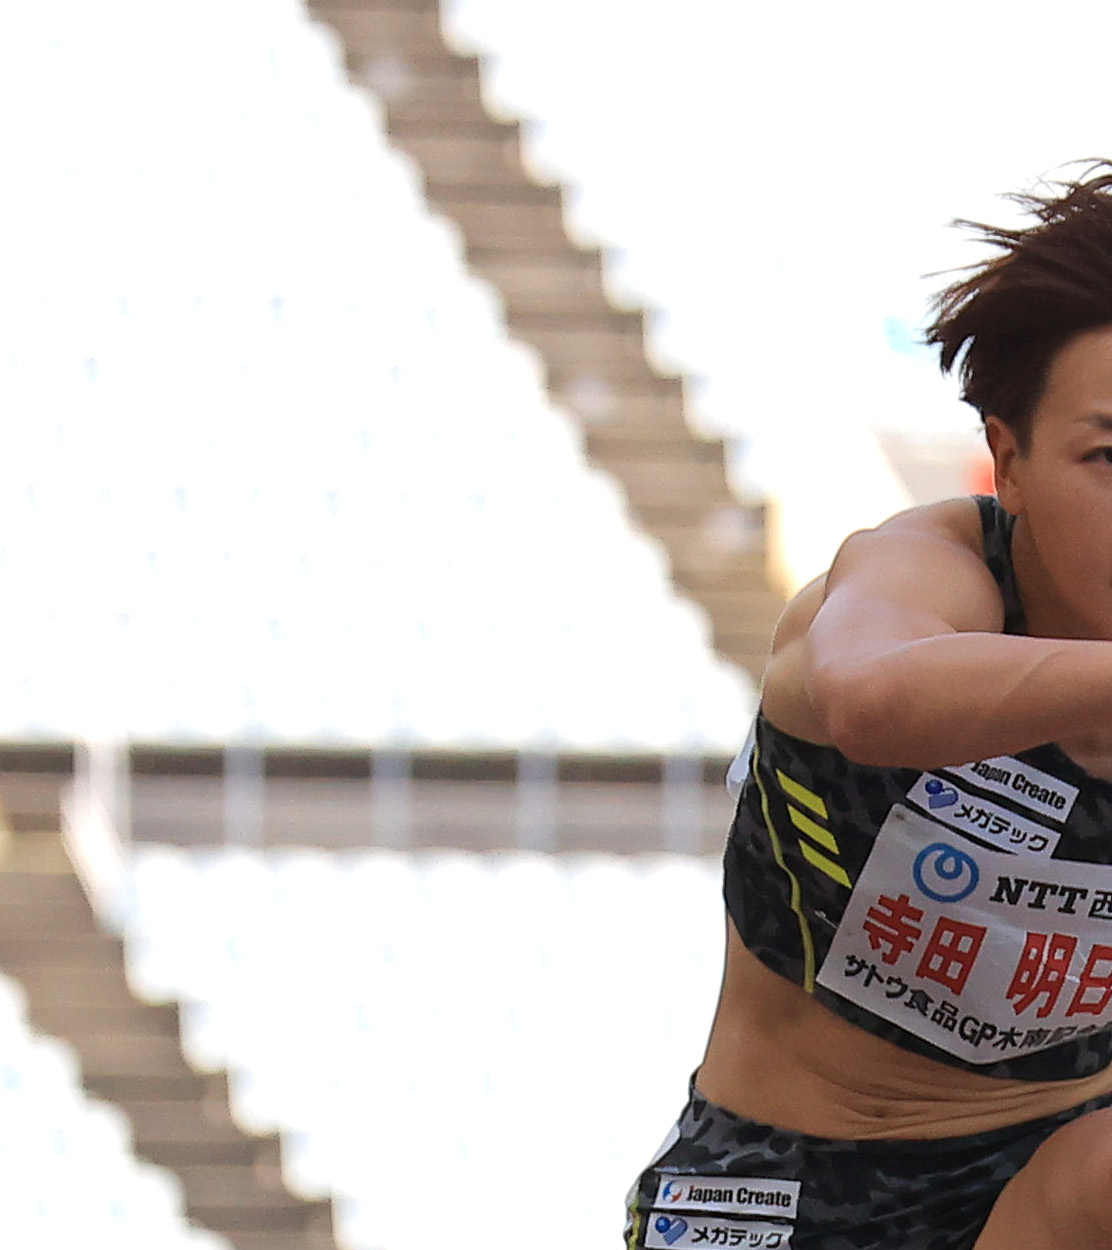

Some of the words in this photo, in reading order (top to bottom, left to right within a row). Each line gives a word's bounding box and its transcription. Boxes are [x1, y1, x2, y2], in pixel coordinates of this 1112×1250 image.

[1011, 769, 1067, 811] Create
[953, 803, 1050, 851] メガテック
[862, 894, 988, 997] 寺田
[687, 1185, 733, 1204] Japan
[736, 1187, 793, 1208] Create
[690, 1226, 785, 1250] メガテック
